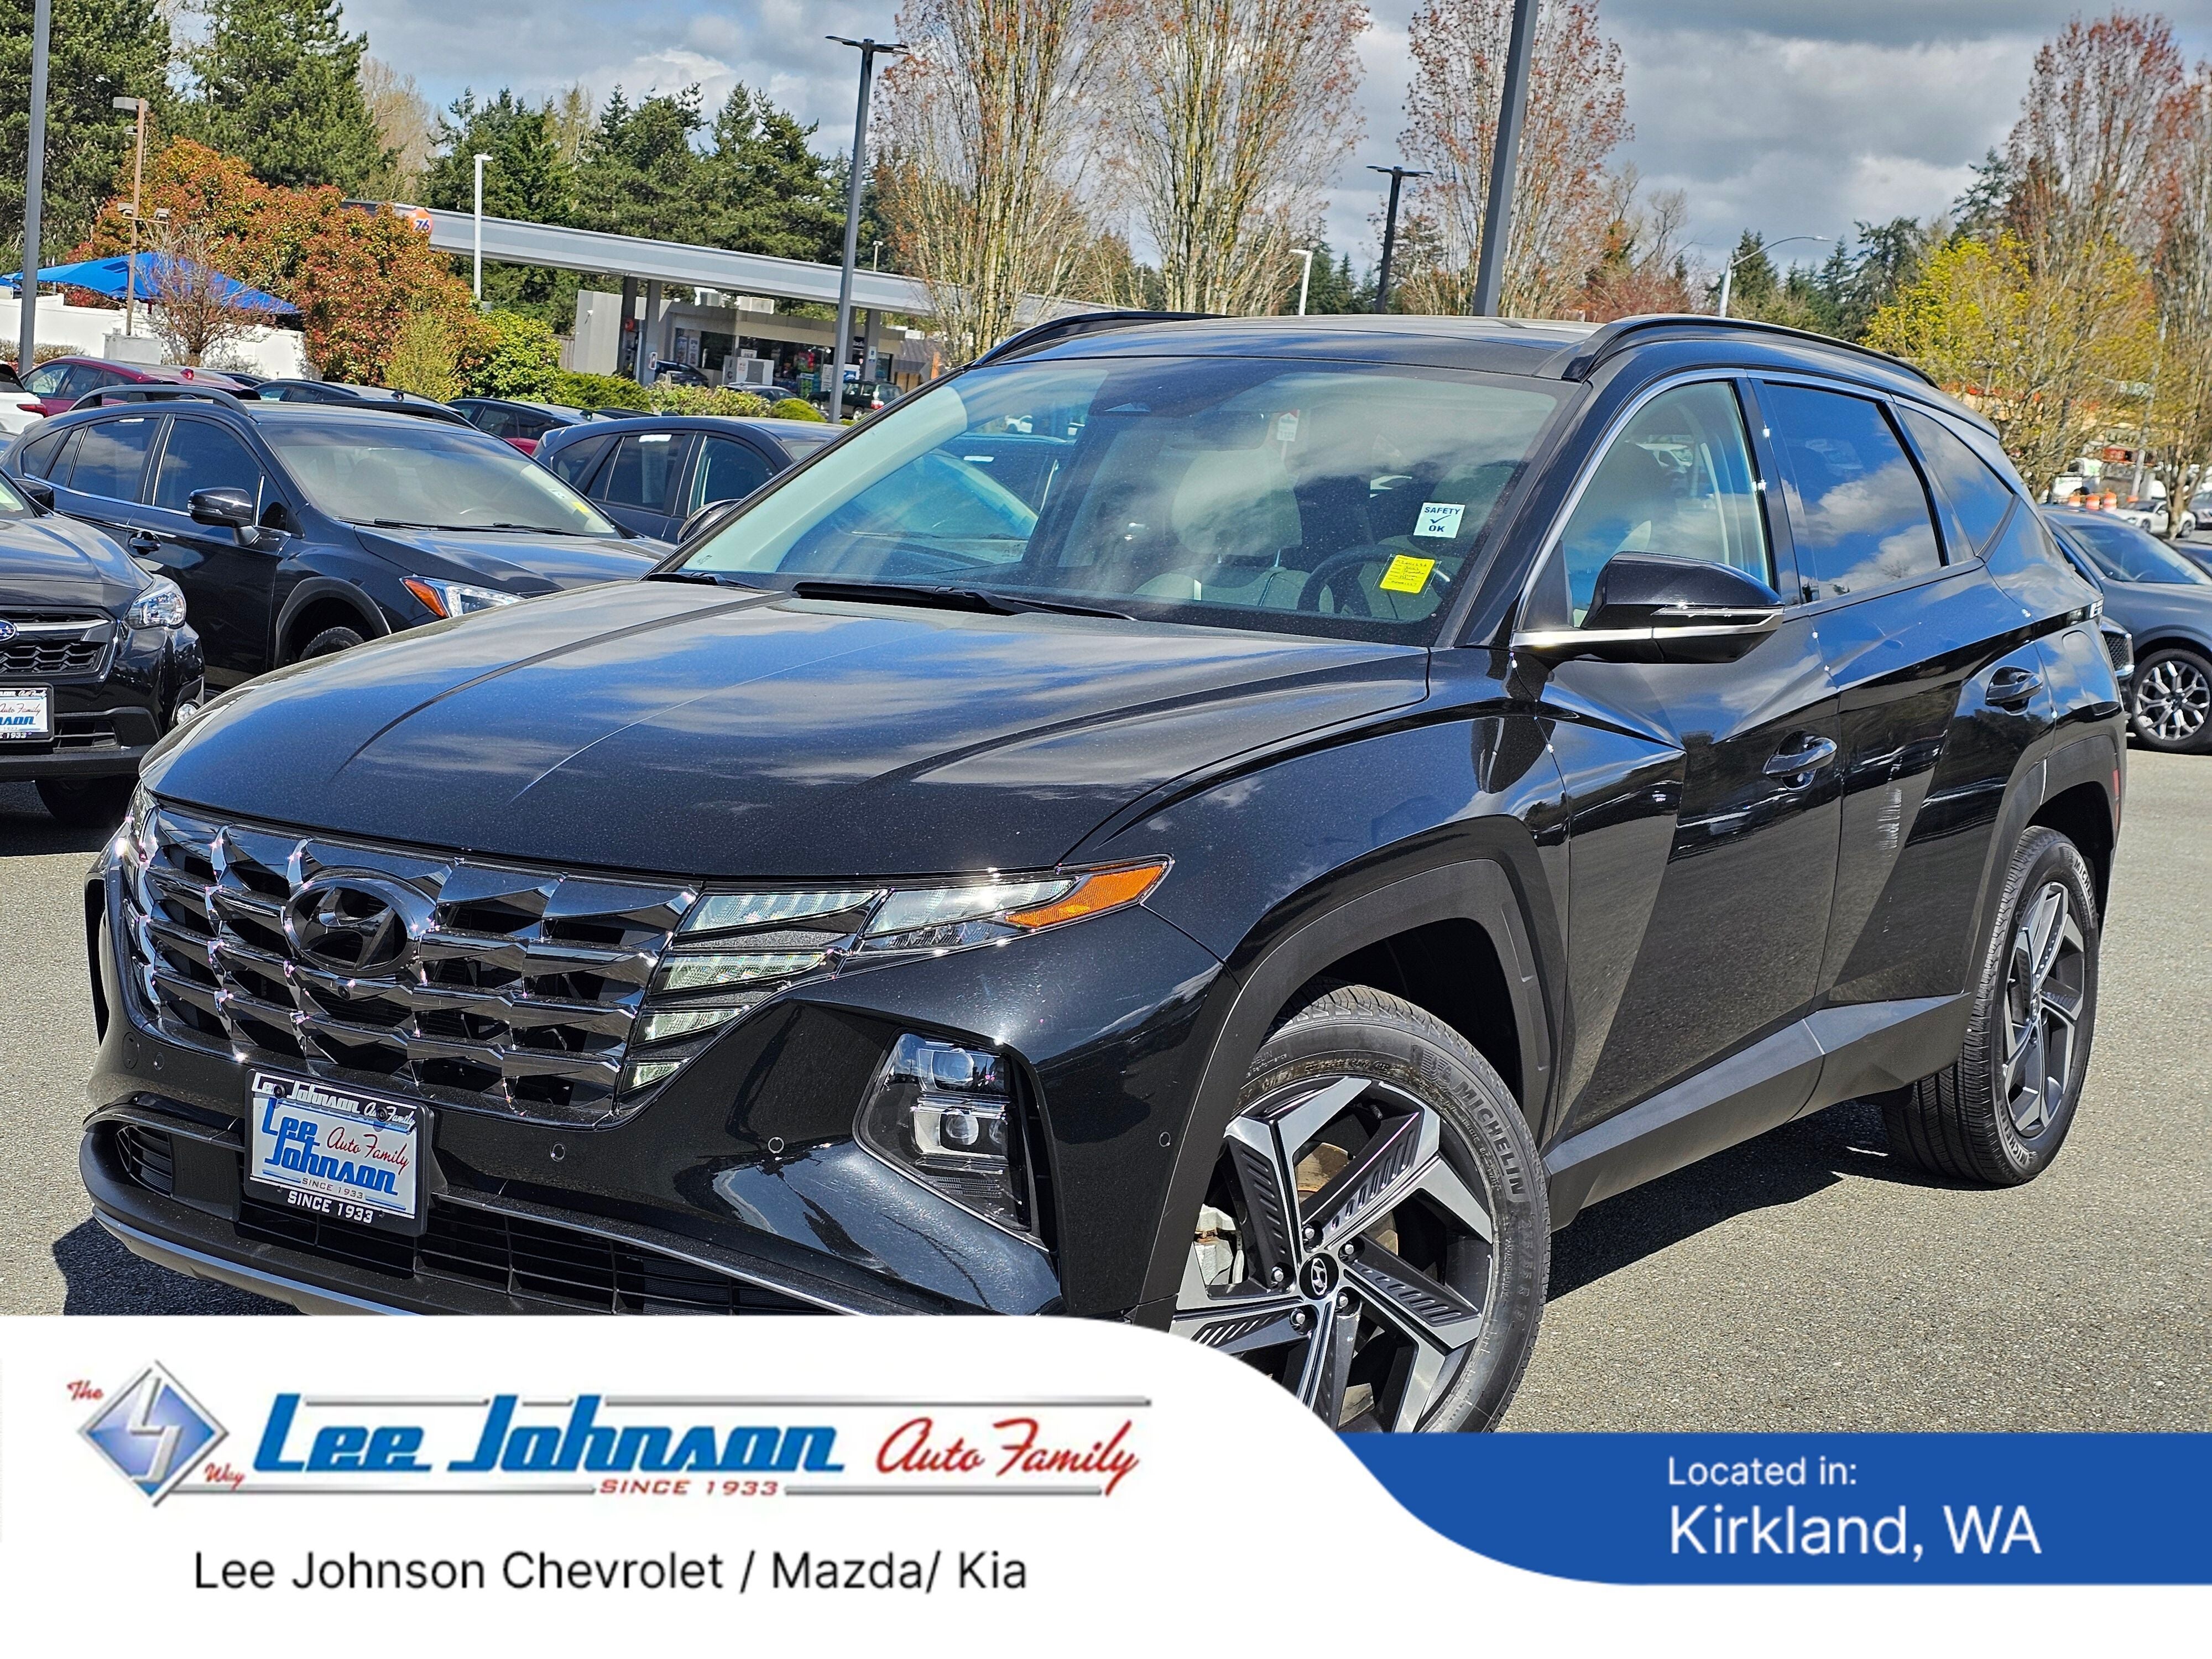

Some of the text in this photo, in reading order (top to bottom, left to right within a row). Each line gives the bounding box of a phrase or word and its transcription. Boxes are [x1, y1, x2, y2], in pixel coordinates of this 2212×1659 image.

[415, 220, 430, 231] 76
[1424, 507, 1460, 515] SAFETY
[252, 1072, 278, 1097] Le
[286, 1080, 361, 1115] Johnson
[385, 1105, 416, 1132] Family
[262, 1097, 321, 1147] Lee
[327, 1126, 410, 1176] Auto Family
[1453, 1081, 1526, 1195] MICHELIN
[264, 1134, 398, 1196] Johnson
[302, 1177, 364, 1199] SINCE 1933
[287, 1191, 373, 1224] SINCE 1933
